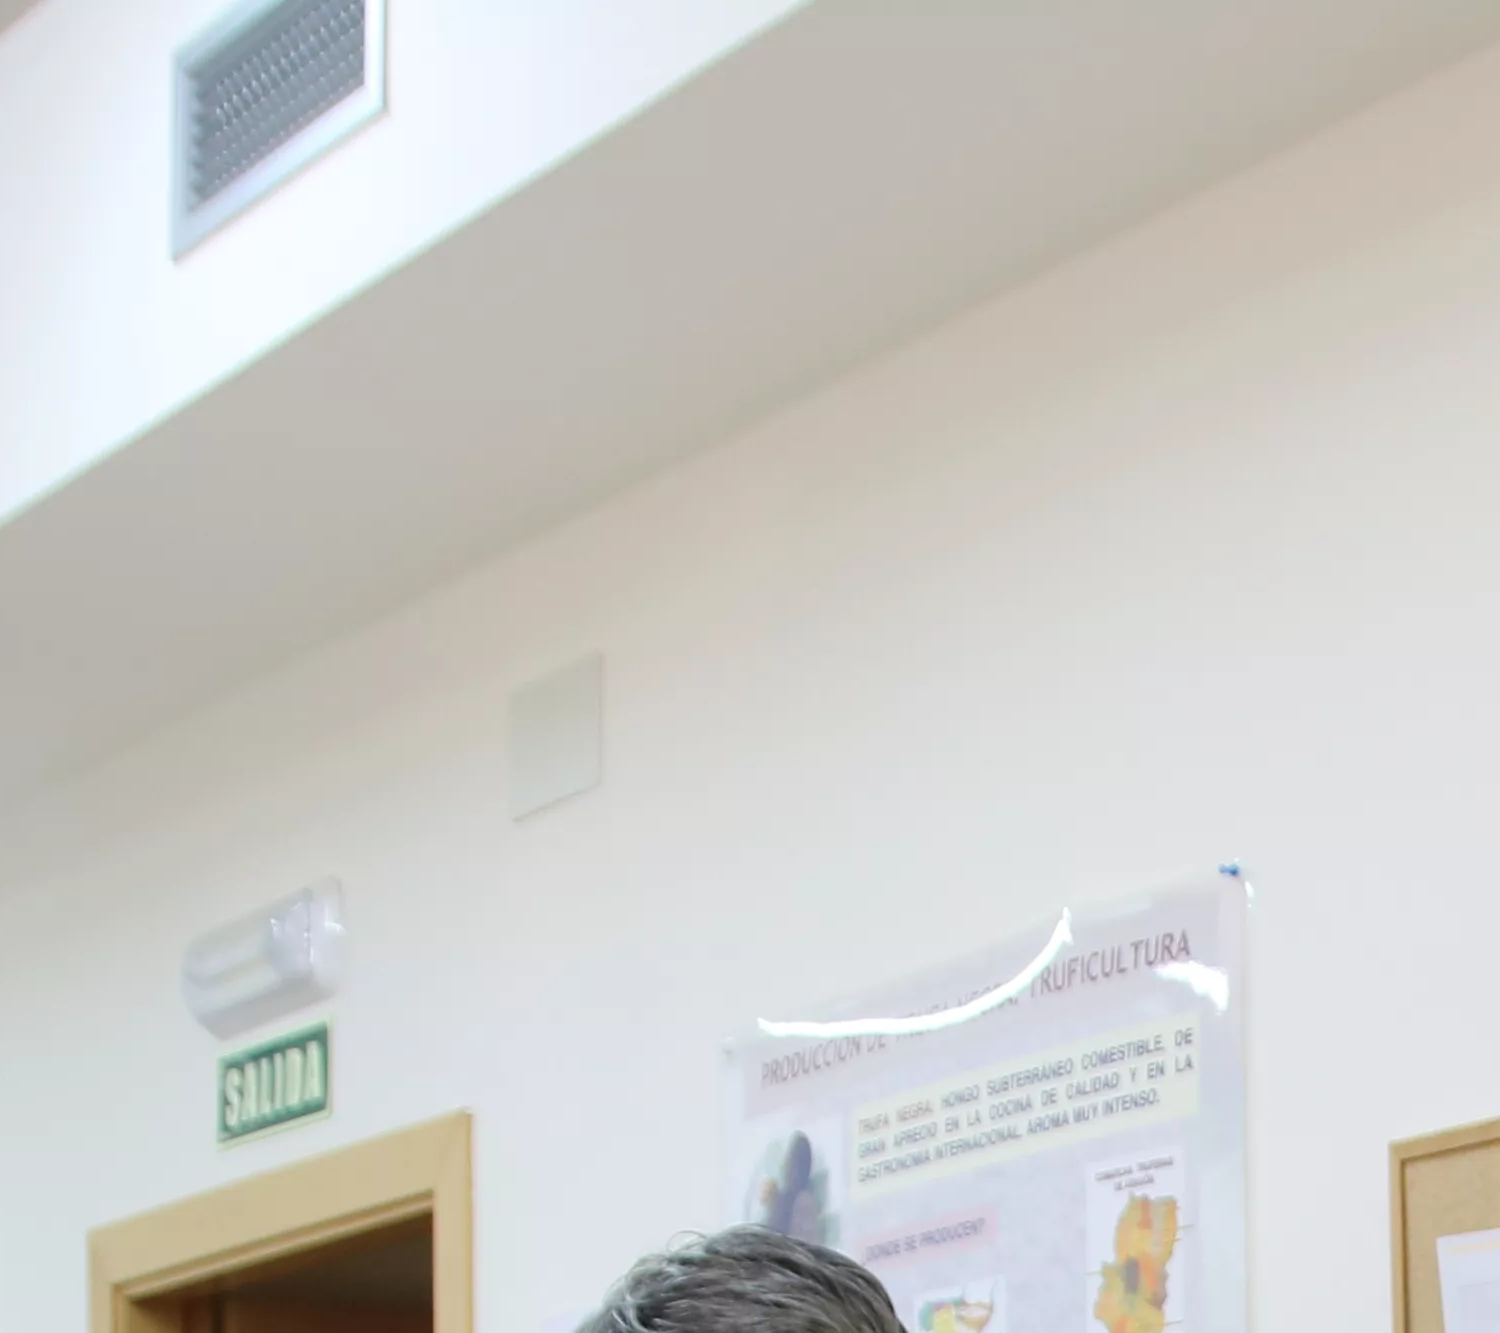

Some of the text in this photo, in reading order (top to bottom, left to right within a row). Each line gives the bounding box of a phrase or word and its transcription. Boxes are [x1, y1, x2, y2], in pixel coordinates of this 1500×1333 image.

[223, 1040, 321, 1128] SALIDA
[858, 1054, 1194, 1159] GRAN APRECIO EN LA COCINA DE CALIDAD Y EN LA
[941, 1084, 980, 1109] HONGO
[1174, 1027, 1194, 1047] DE
[1026, 1109, 1069, 1135] AROMA
[1072, 1102, 1099, 1123] MUY
